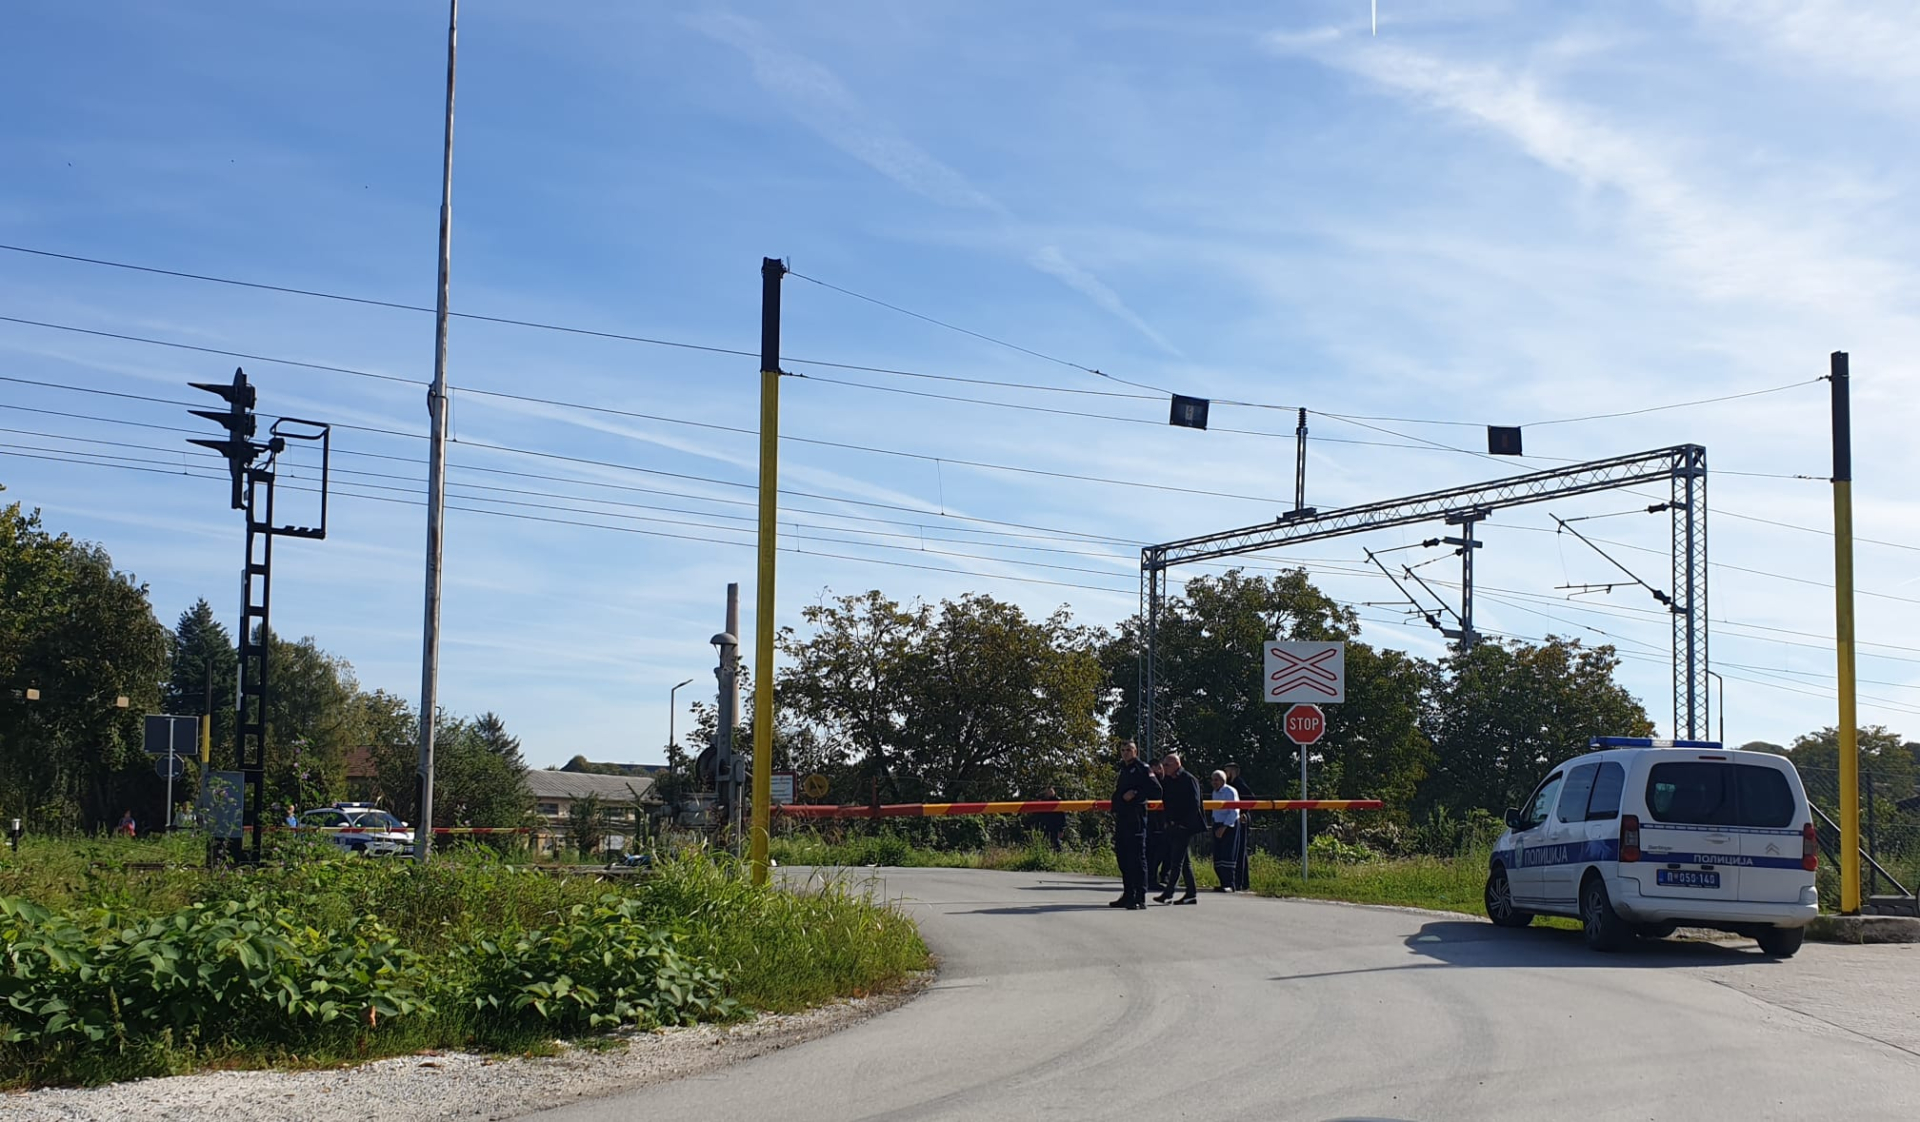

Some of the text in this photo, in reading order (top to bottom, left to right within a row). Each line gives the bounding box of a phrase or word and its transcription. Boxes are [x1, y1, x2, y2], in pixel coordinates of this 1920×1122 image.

[1290, 717, 1319, 730] STOP
[1524, 845, 1568, 866] ПОЛИЦИЈА
[1694, 854, 1753, 866] ПОЛИЦИЈА
